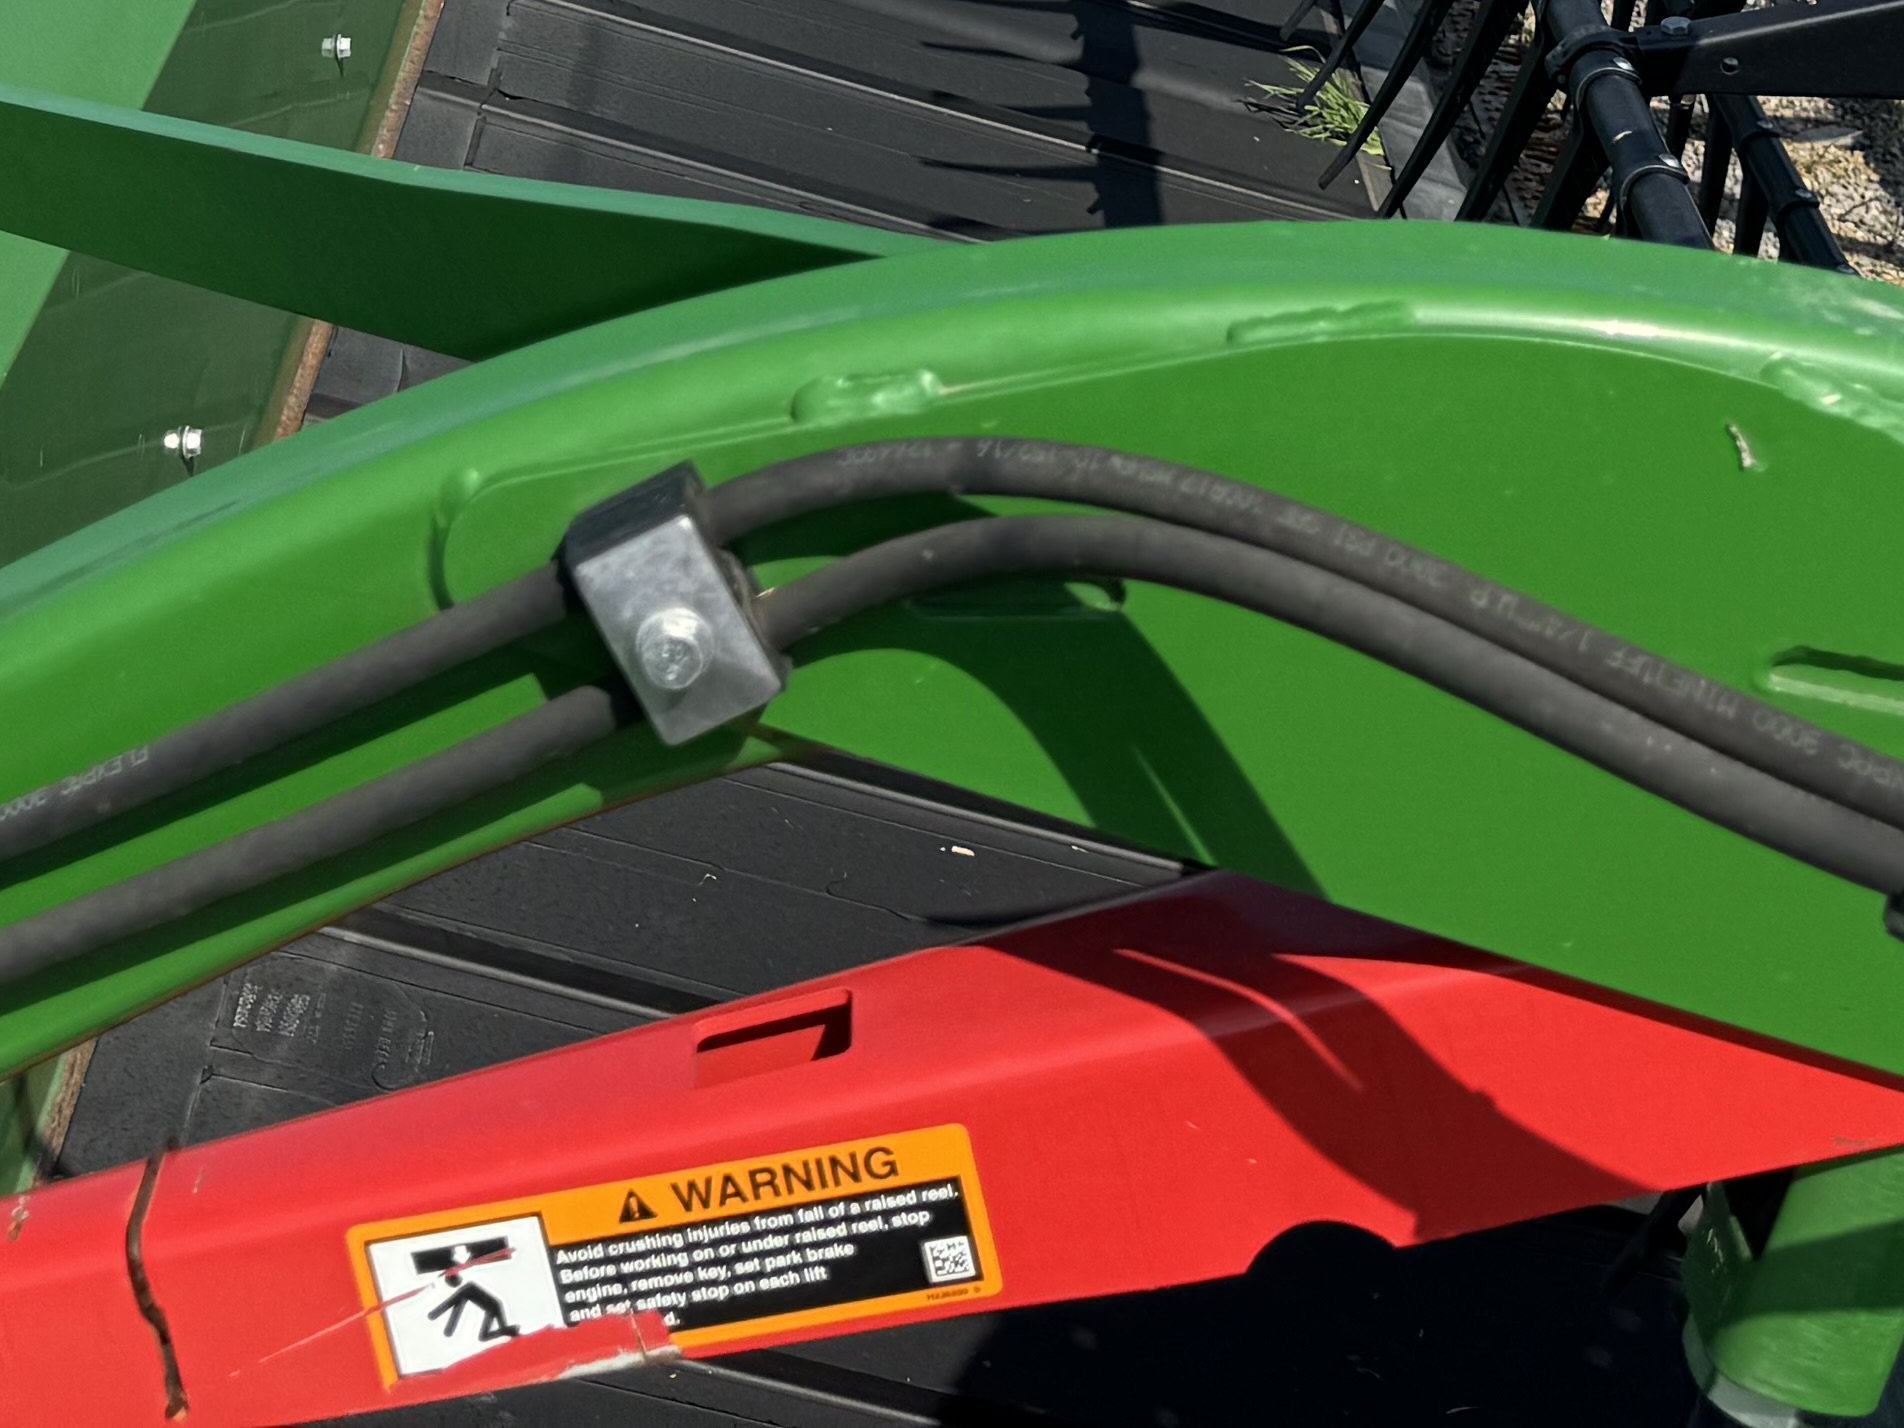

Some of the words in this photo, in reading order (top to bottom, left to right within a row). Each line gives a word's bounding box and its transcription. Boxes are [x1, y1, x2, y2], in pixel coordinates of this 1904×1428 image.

[670, 1145, 900, 1214] WARNING
[557, 1245, 604, 1265] Avoid
[608, 1231, 684, 1256] crushing
[688, 1220, 751, 1243] injuries
[754, 1213, 794, 1230] from
[798, 1204, 824, 1224] fall
[829, 1202, 845, 1219] of
[850, 1202, 861, 1214] a
[865, 1189, 917, 1211] raised
[561, 1263, 617, 1284] Before
[621, 1251, 688, 1274] working
[693, 1247, 715, 1262] on
[719, 1243, 737, 1258] or
[742, 1234, 790, 1254] under
[795, 1221, 847, 1244] raised
[851, 1215, 889, 1234] reel,
[892, 1209, 930, 1228] stop
[565, 1282, 628, 1304] engine,
[631, 1270, 694, 1291] remove
[698, 1263, 731, 1282] key,
[735, 1256, 760, 1275] set
[765, 1252, 803, 1273] park
[806, 1241, 855, 1261] brake
[570, 1304, 601, 1322] and
[606, 1299, 631, 1315] set
[636, 1290, 686, 1311] safety
[691, 1282, 729, 1303] stop
[733, 1279, 755, 1295] on
[759, 1271, 800, 1290] each
[804, 1264, 827, 1283] lift
